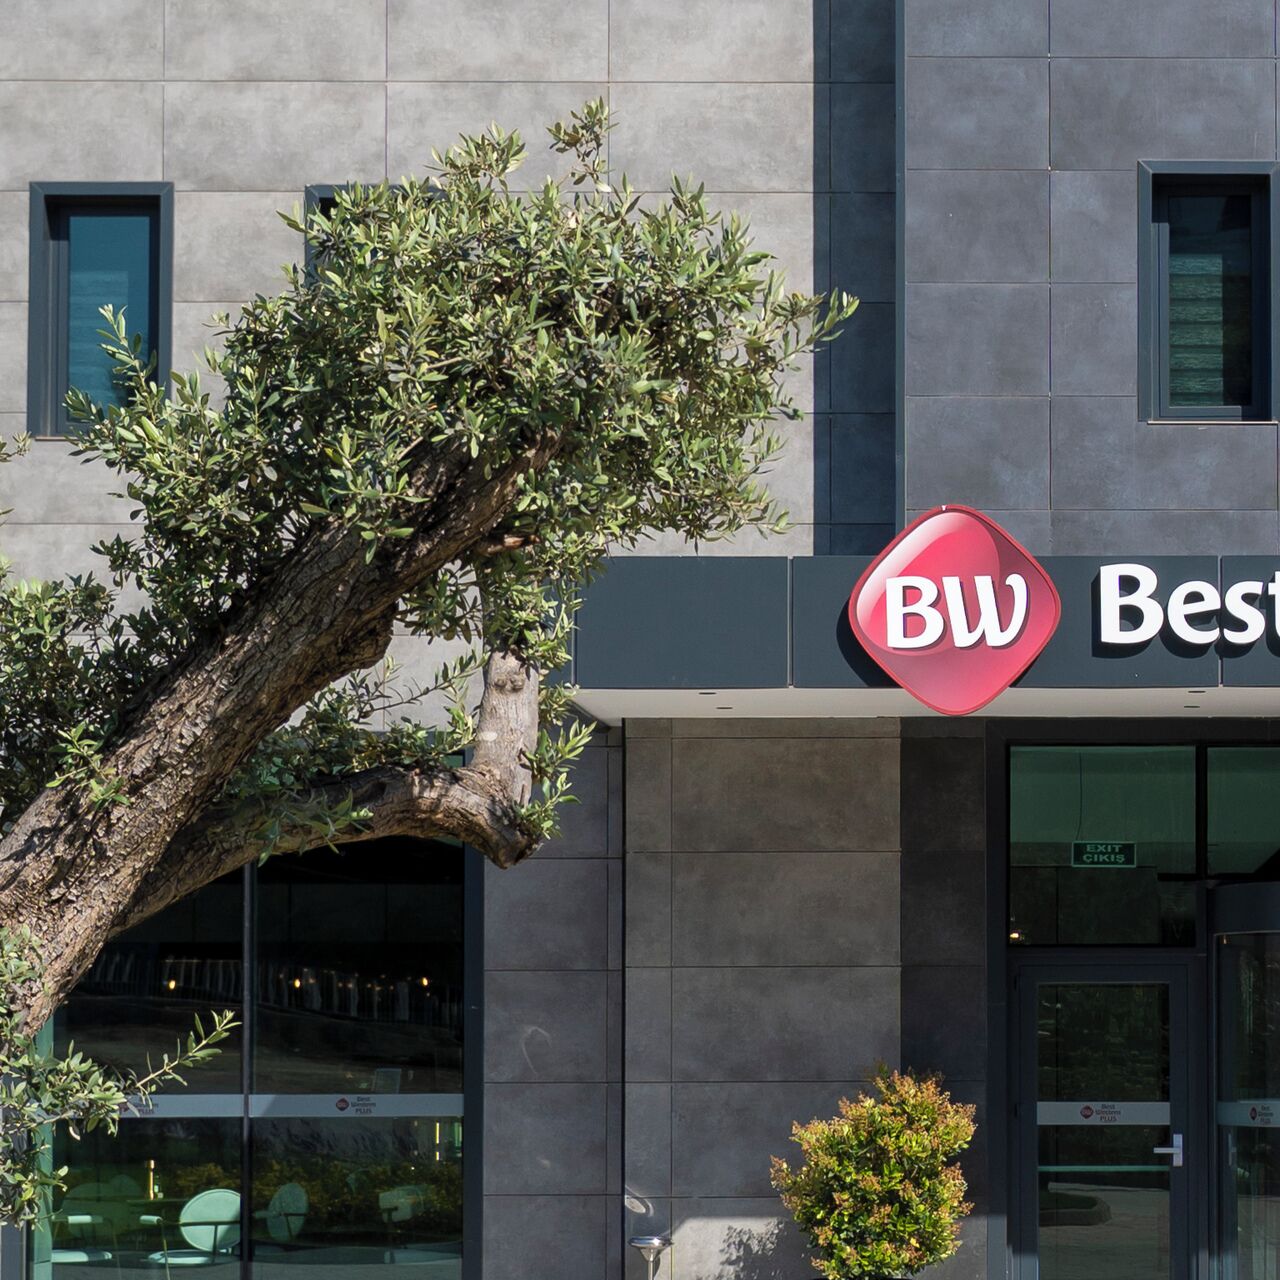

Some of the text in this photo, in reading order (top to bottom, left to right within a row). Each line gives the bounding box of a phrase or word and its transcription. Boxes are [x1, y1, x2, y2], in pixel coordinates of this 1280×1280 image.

[879, 569, 1028, 649] BW
[1086, 844, 1122, 852] EXIT
[1083, 854, 1125, 863] ÇIKIŞ
